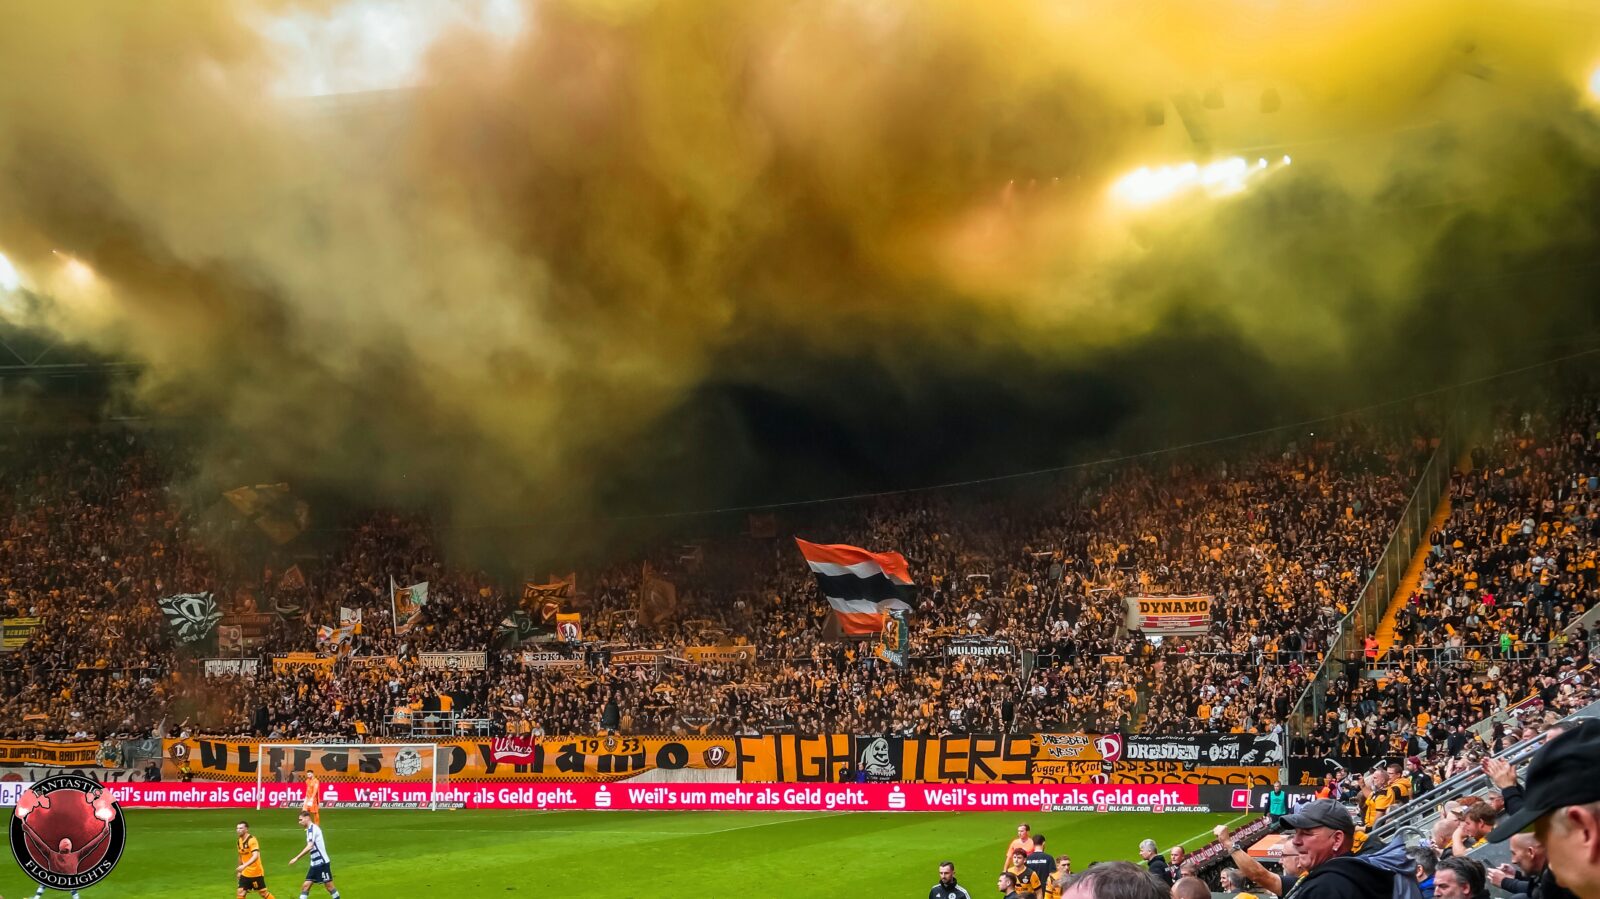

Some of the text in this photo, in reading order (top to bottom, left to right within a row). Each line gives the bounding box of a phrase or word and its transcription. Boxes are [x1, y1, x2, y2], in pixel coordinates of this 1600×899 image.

[1139, 601, 1208, 613] DYNAMO
[948, 646, 1011, 655] MULDENTAL
[581, 740, 599, 753] 19
[621, 739, 640, 752] 53
[1041, 734, 1089, 747] DRESDEN
[144, 790, 165, 802] um
[169, 787, 206, 802] mehr
[209, 787, 230, 802] als
[233, 787, 265, 802] Geld
[269, 787, 306, 806] geht.
[354, 788, 576, 807] Weil's um mehr als Geld geht.
[628, 788, 868, 808] Weil's um mehr als Geld geht.
[924, 789, 1184, 805] Weil's um mehr als Geld geht.
